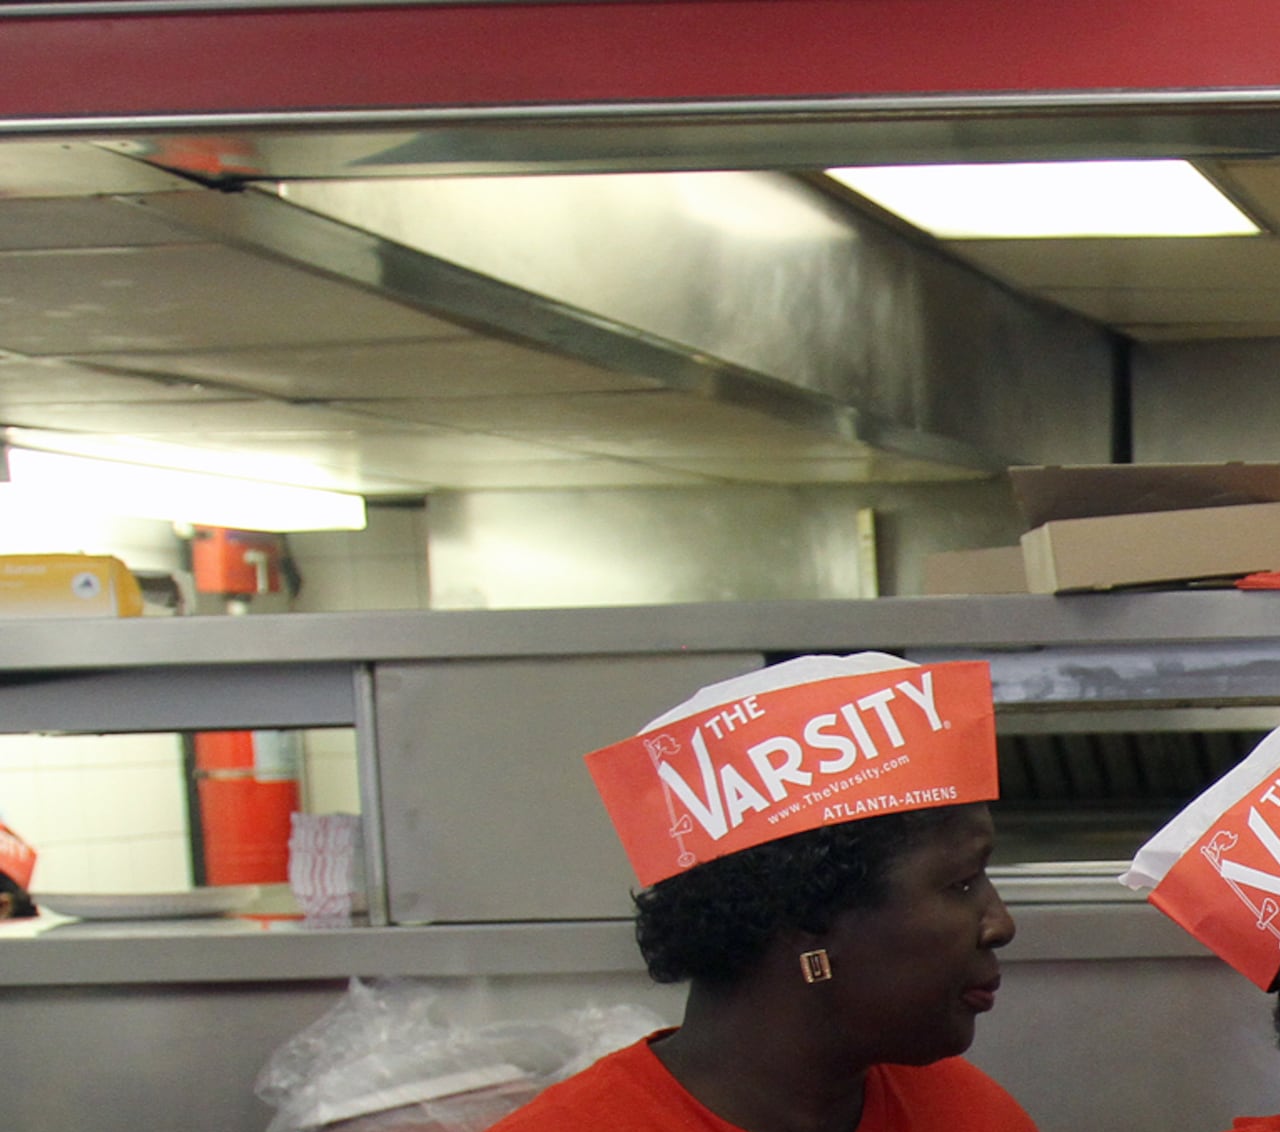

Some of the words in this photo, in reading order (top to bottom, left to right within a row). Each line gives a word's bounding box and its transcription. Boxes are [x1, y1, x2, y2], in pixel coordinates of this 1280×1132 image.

[704, 695, 766, 741] THE
[658, 672, 942, 841] VARSITY
[767, 754, 911, 825] www.TheVarsity.com
[822, 786, 958, 822] ATLANTA-ATHENS
